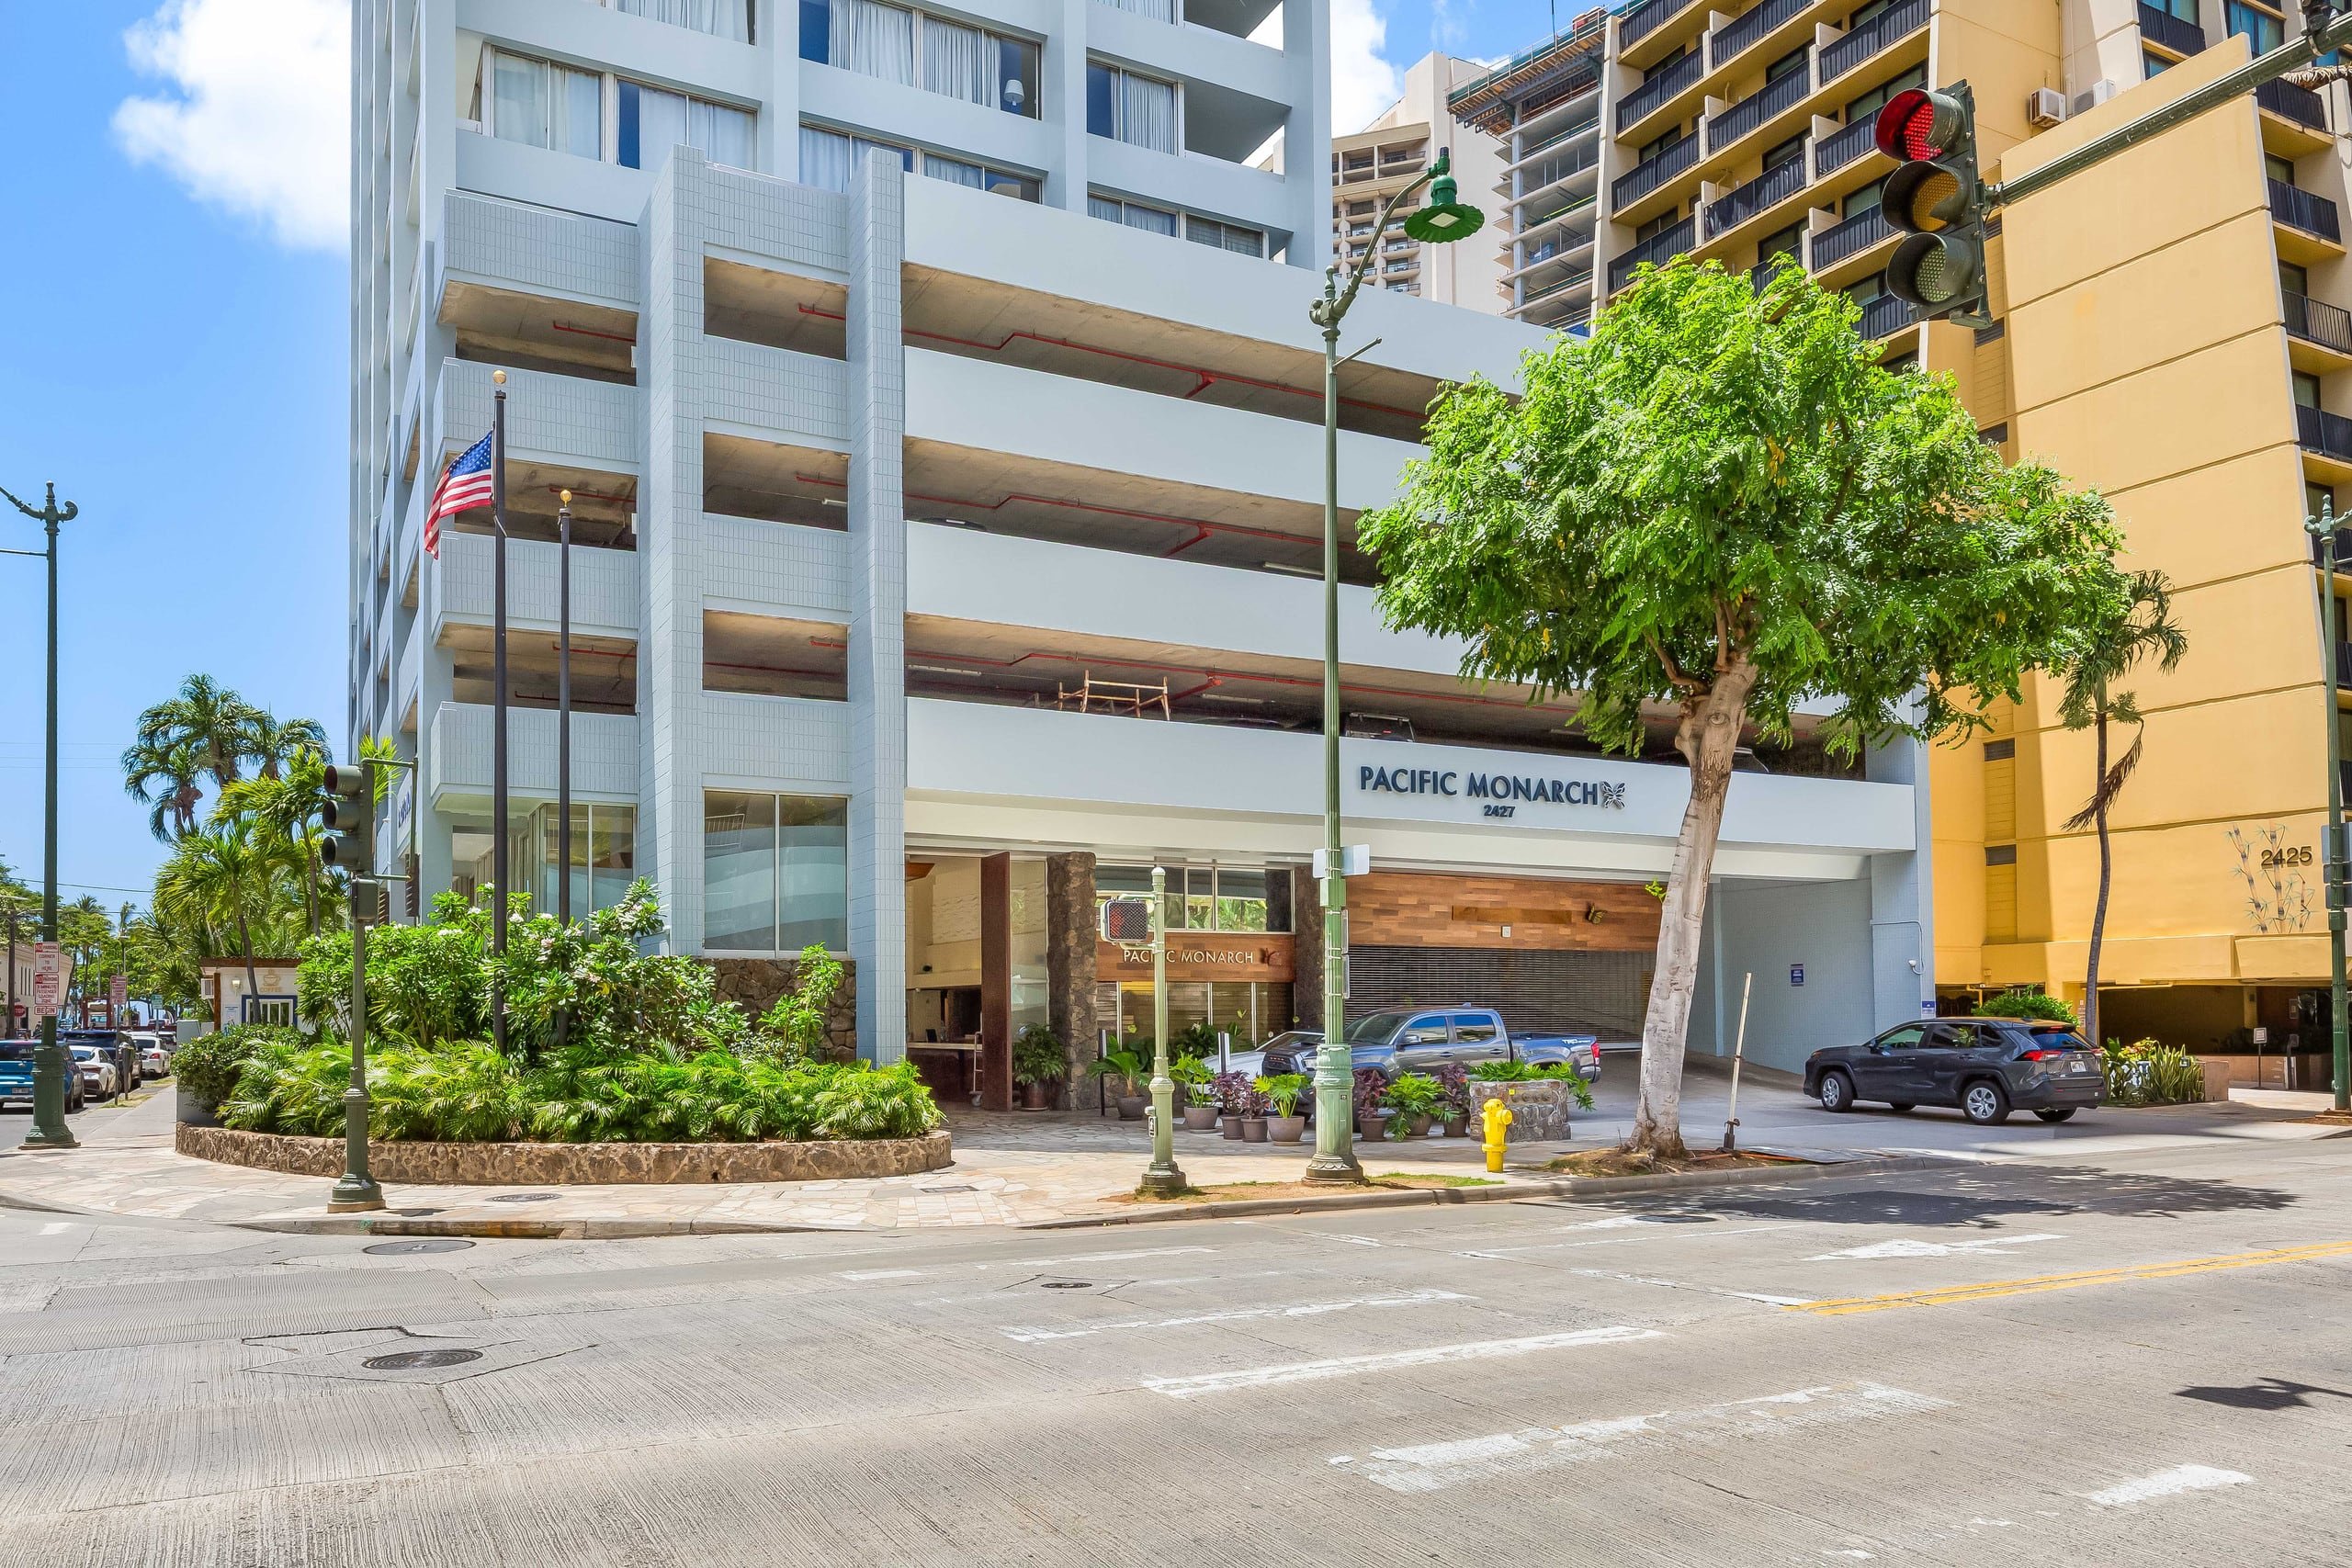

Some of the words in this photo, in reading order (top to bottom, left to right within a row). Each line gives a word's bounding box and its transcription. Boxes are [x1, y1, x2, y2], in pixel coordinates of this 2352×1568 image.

[1360, 765, 1458, 796] PACIFIC
[1466, 772, 1599, 806] MONARCH
[1483, 804, 1516, 818] 2427
[2260, 845, 2312, 868] 2425
[1124, 950, 1176, 963] PACIC
[1181, 950, 1254, 964] MONARCH
